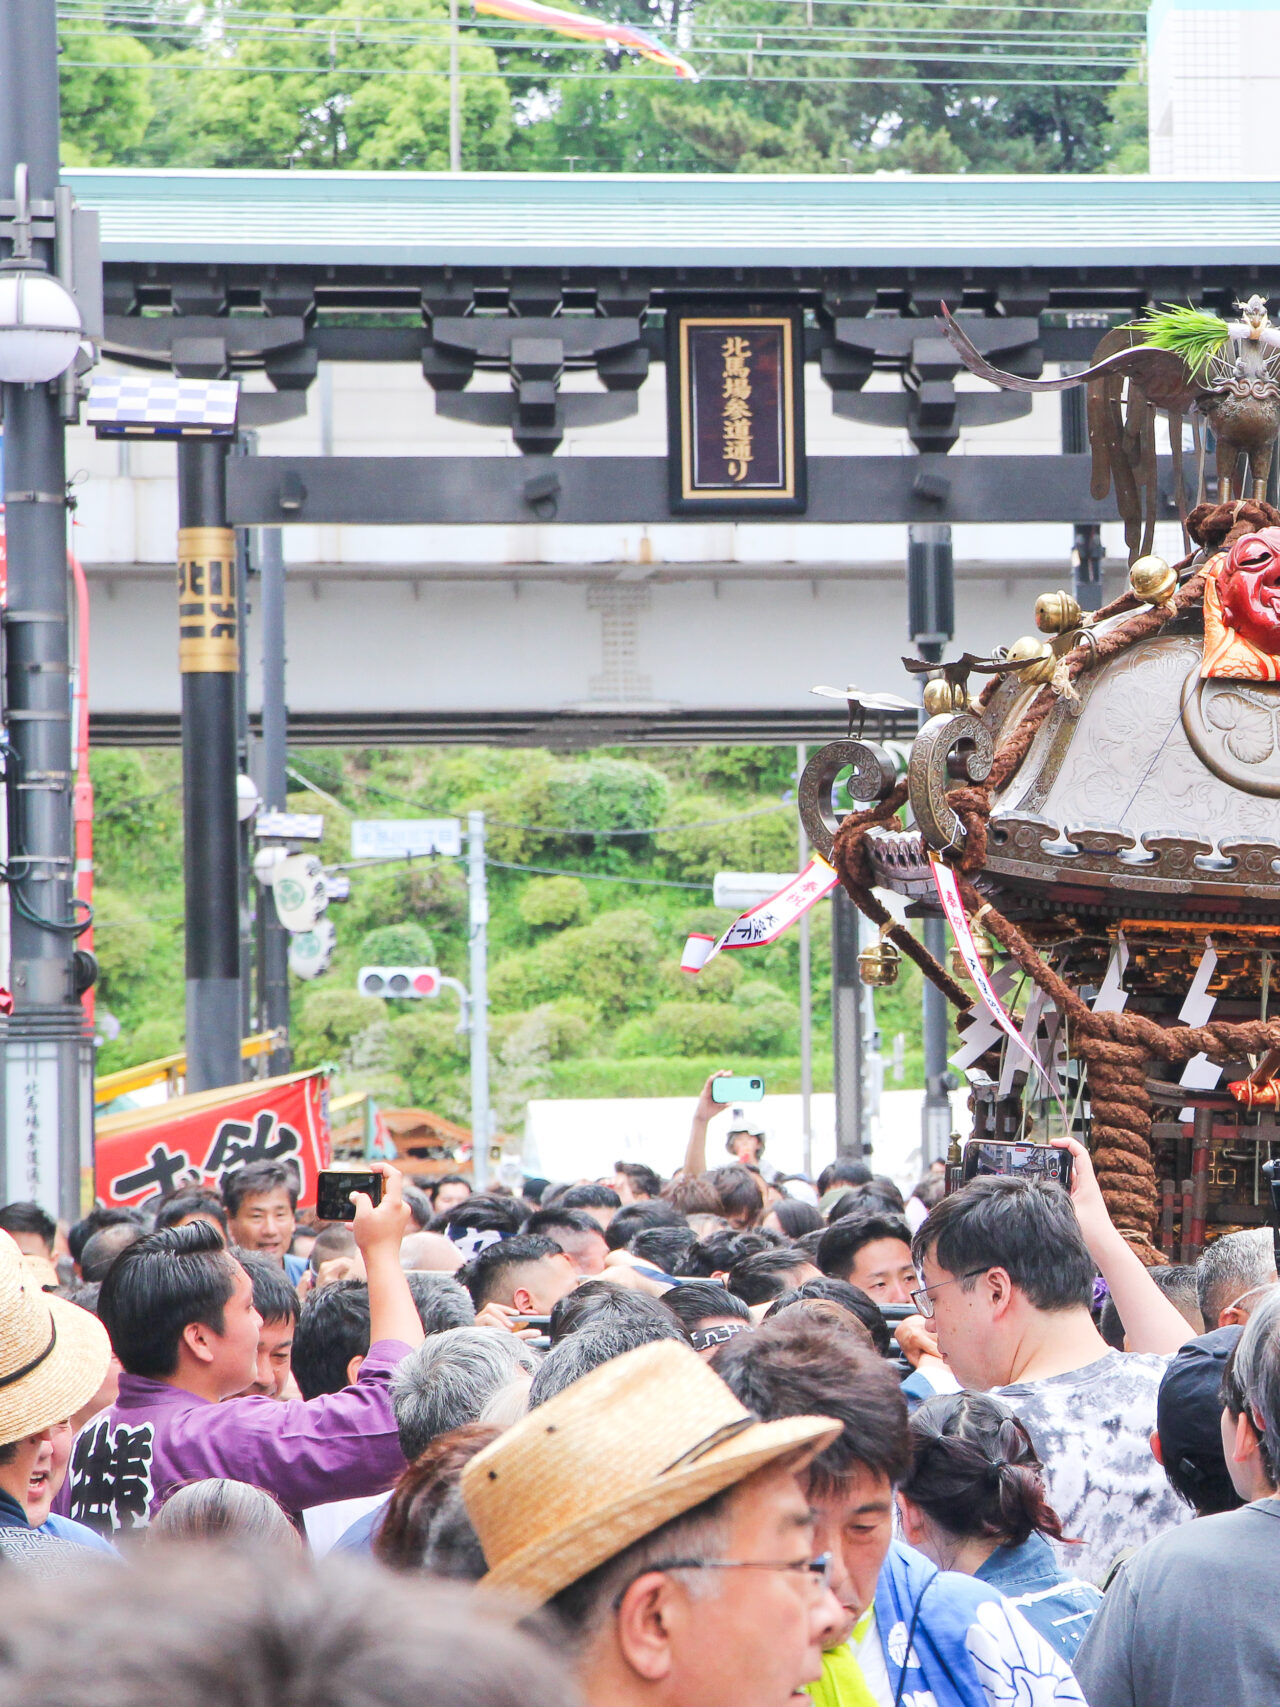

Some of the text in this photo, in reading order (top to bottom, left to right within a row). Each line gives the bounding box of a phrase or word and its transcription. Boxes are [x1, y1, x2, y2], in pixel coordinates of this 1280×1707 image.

[721, 336, 754, 482] 北馬場参道通り
